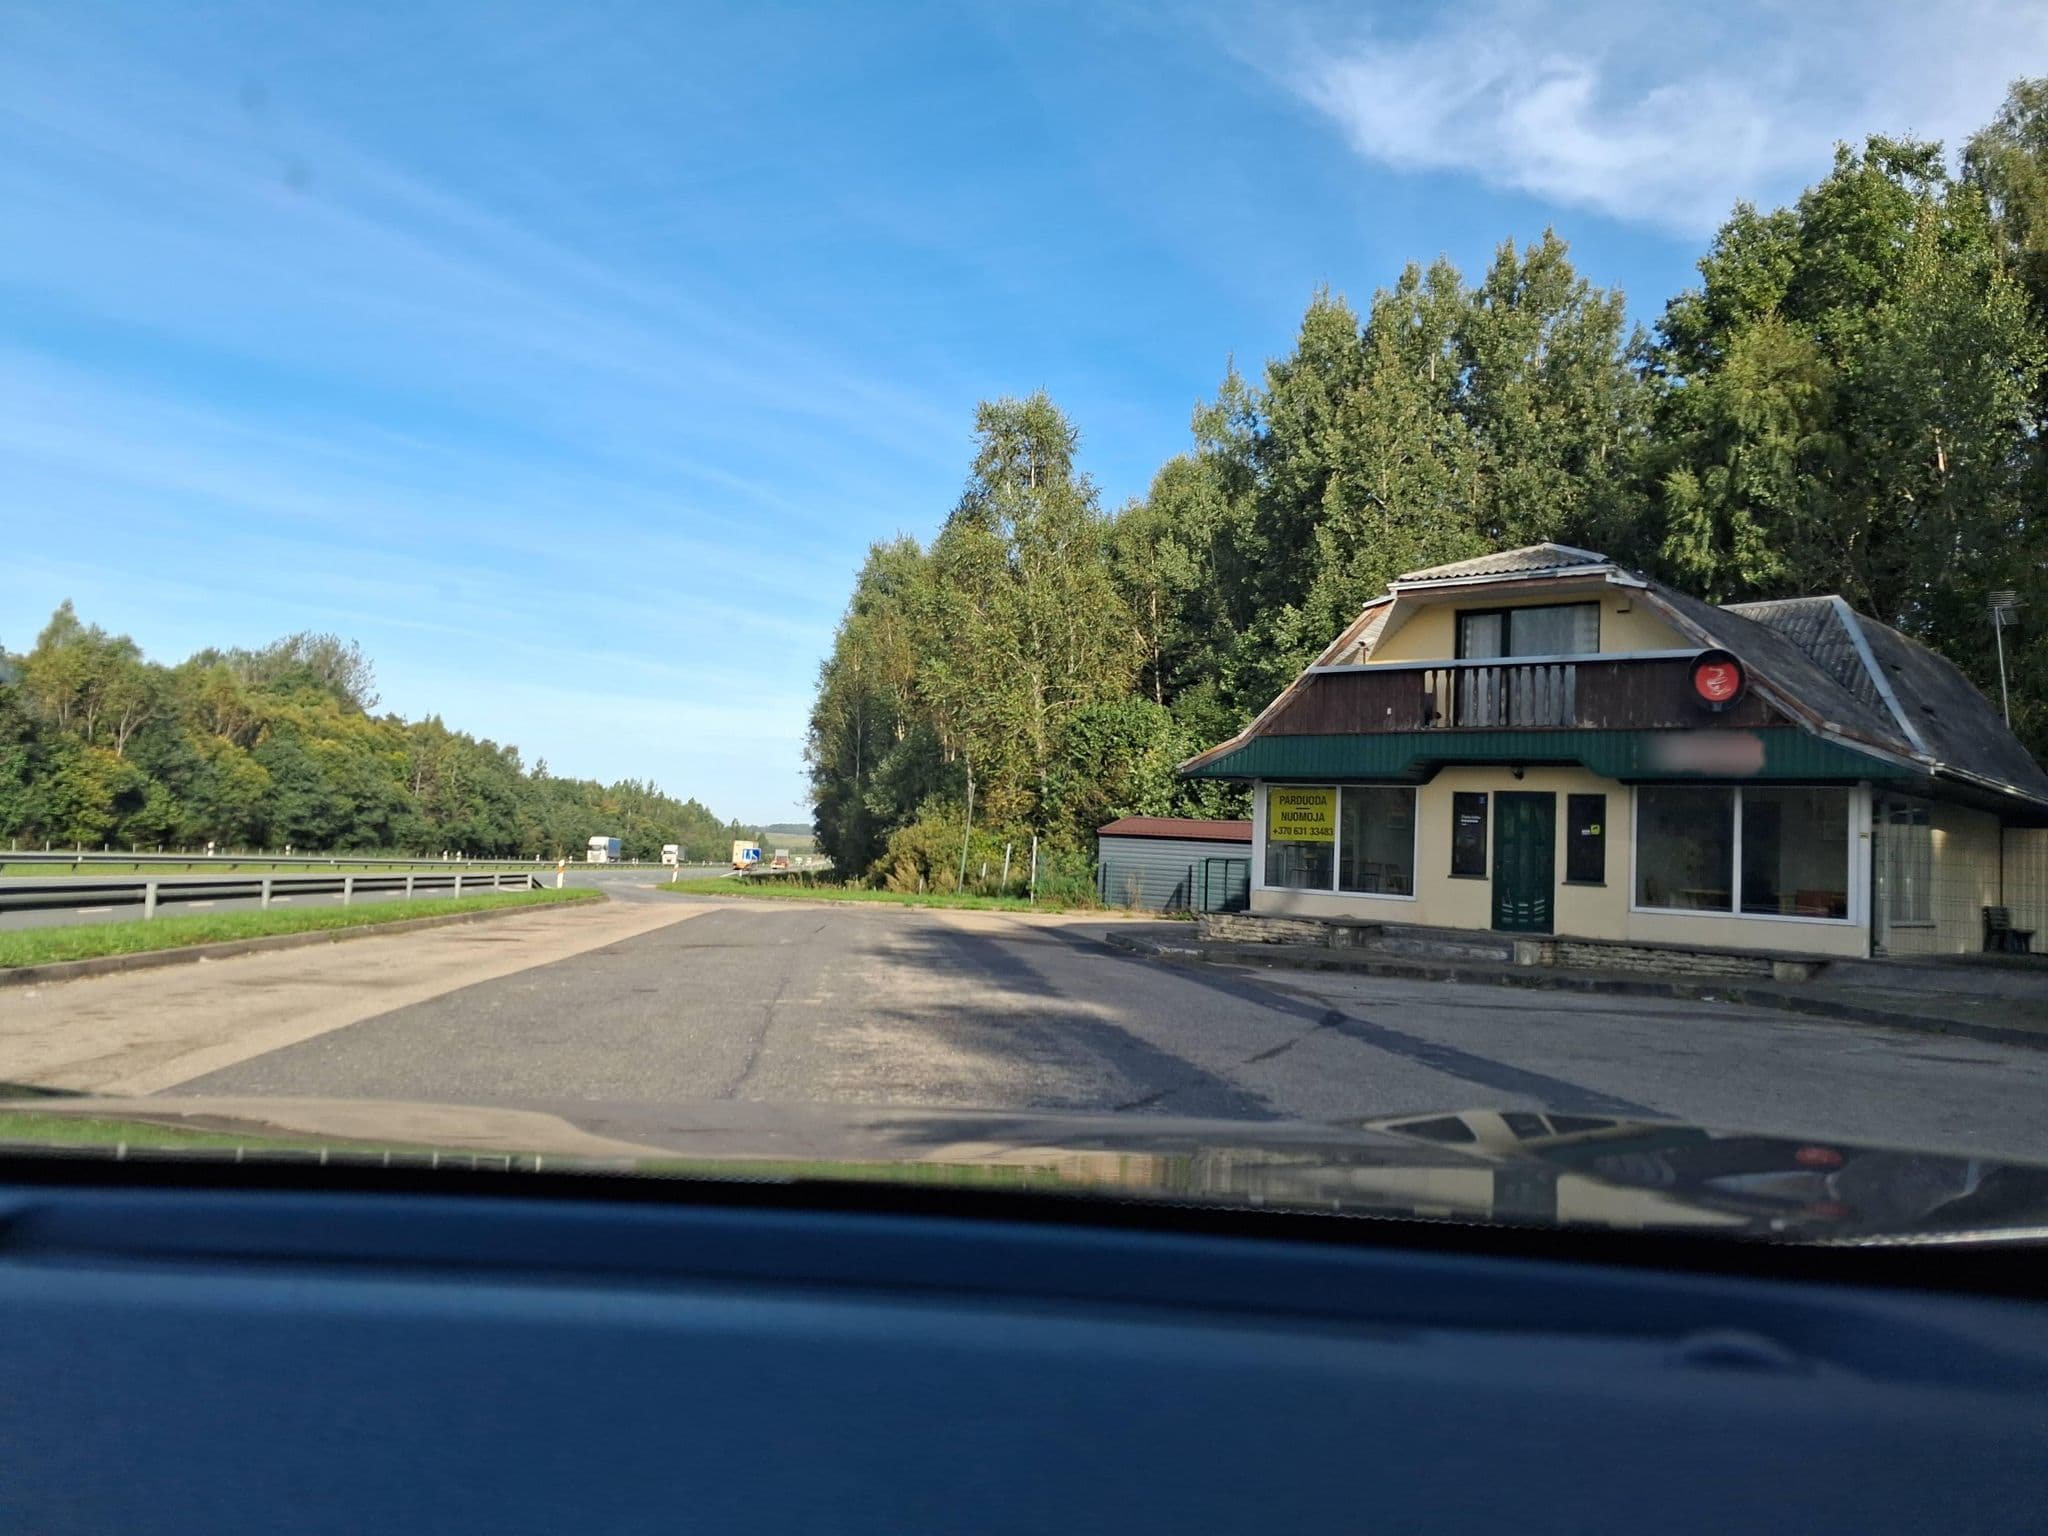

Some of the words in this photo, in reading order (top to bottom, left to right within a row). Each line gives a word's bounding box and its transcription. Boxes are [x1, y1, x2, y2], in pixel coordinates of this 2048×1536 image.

[1280, 795, 1327, 806] PARDUODA
[1281, 812, 1325, 822] NUOMOJA
[1273, 826, 1292, 835] +370
